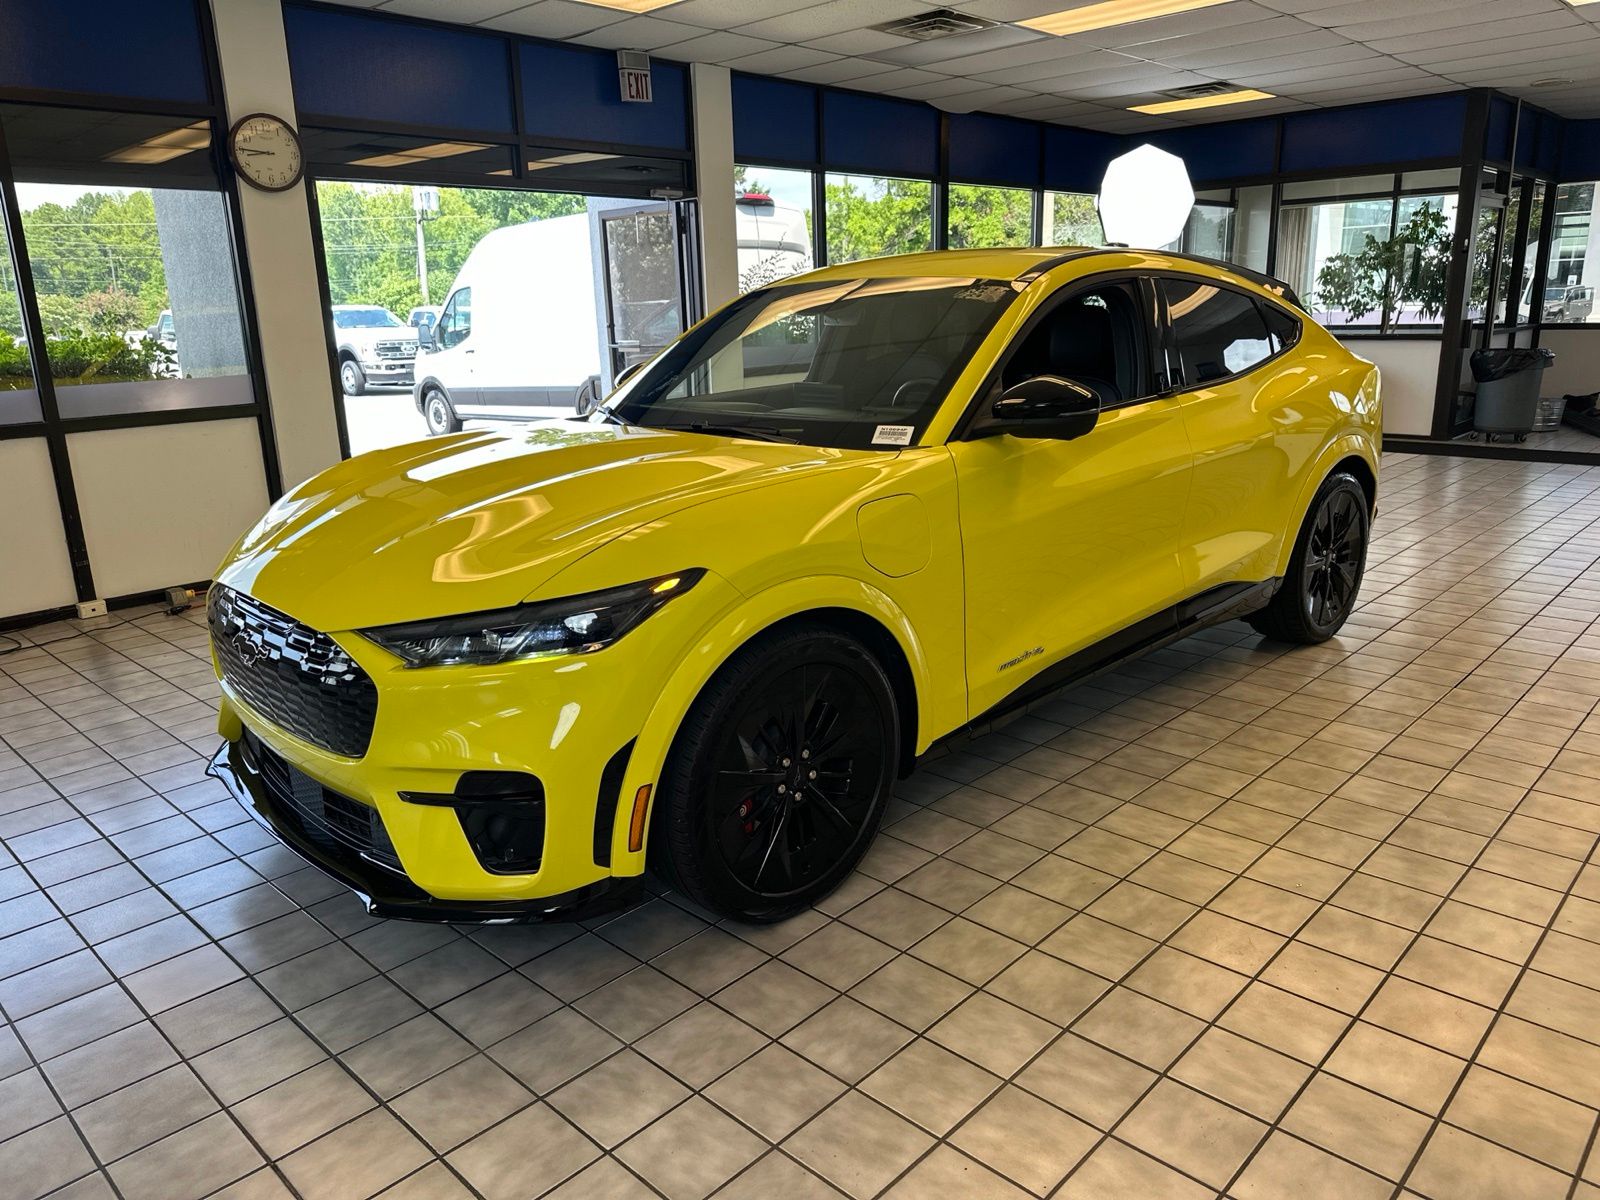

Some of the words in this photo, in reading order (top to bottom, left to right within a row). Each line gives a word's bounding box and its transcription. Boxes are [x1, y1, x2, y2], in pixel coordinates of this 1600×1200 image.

[627, 72, 649, 100] EXIT
[250, 125, 258, 134] 11
[261, 123, 270, 132] 12
[242, 134, 251, 143] 10
[285, 138, 291, 146] 2
[255, 170, 261, 179] 7
[268, 175, 275, 184] 6
